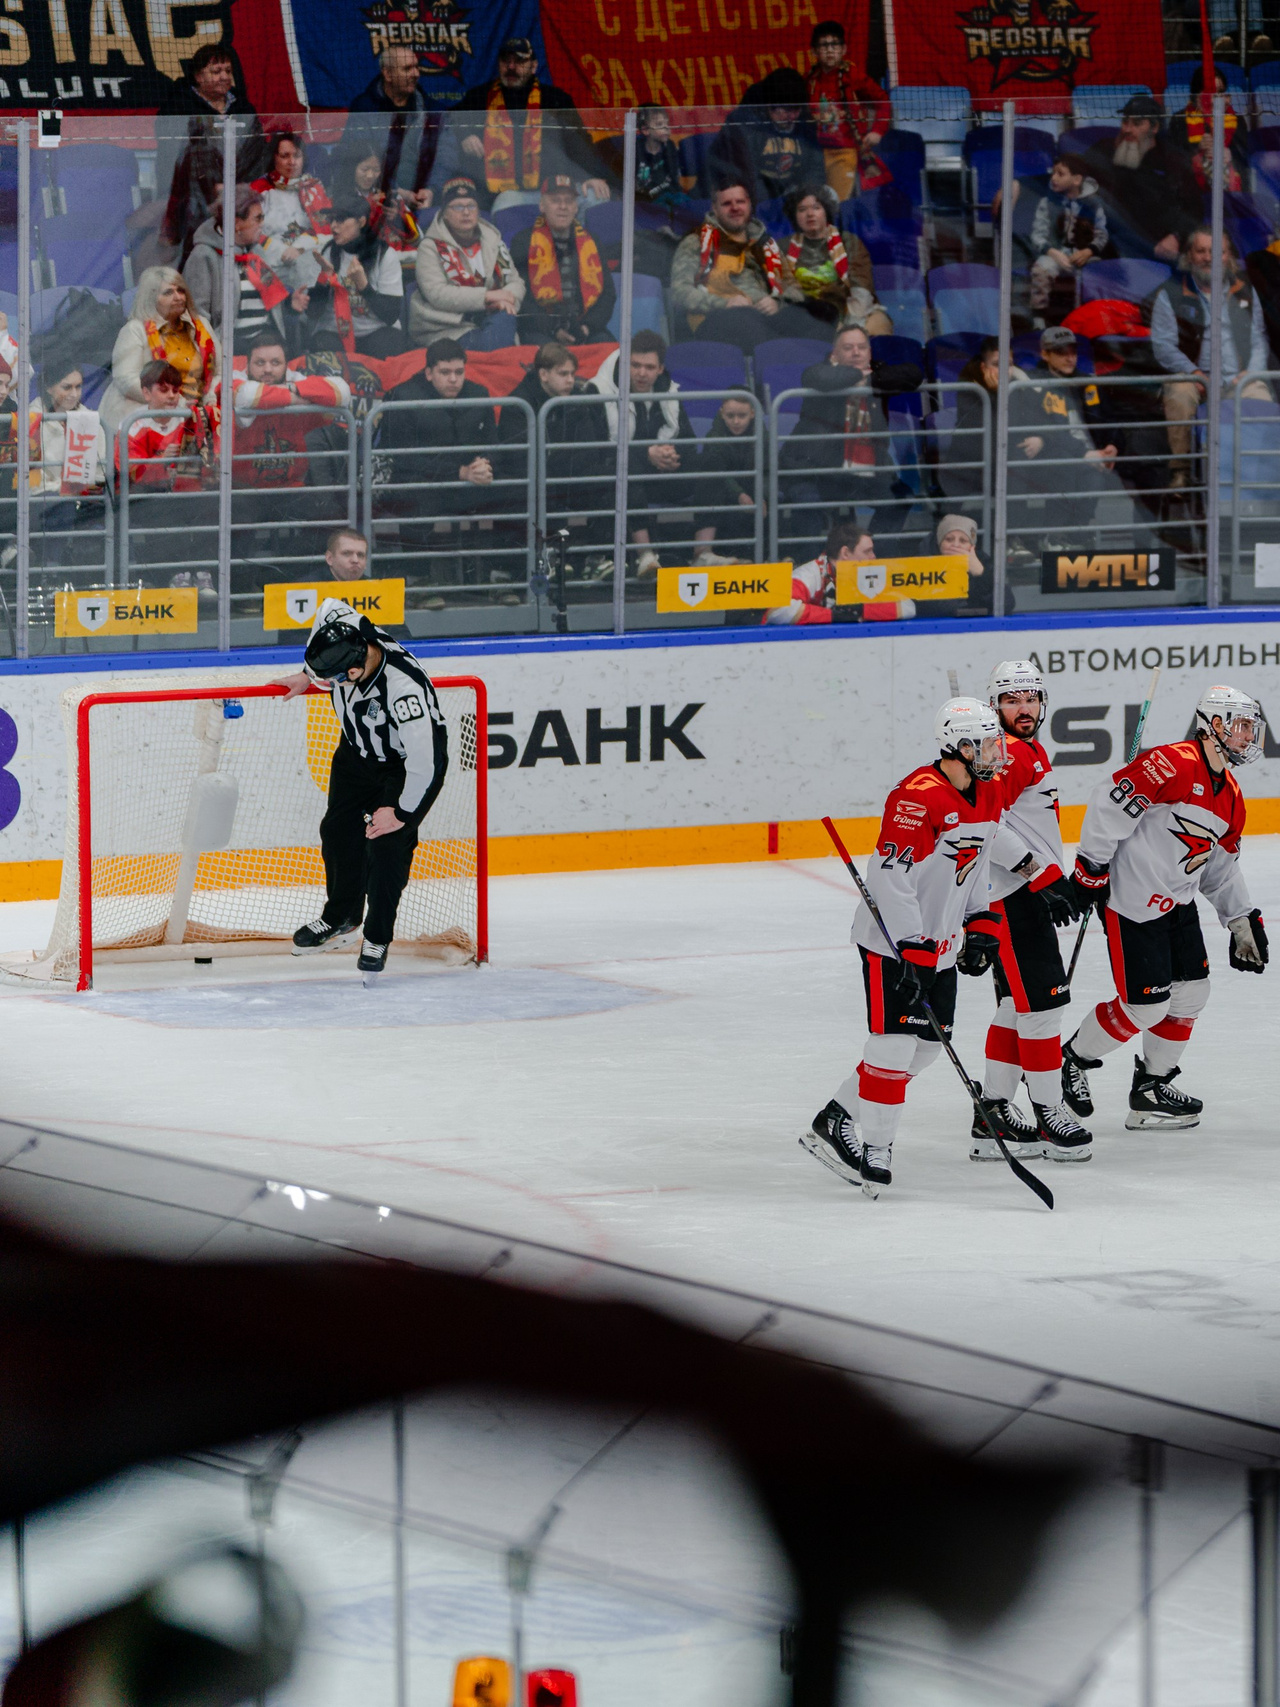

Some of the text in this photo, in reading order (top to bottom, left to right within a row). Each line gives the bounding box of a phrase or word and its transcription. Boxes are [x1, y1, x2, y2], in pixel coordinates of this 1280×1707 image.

[963, 27, 1094, 61] REDSTAR
[581, 54, 639, 110] ЗА
[713, 578, 770, 595] БАНК
[891, 570, 948, 587] БАНК
[1056, 553, 1161, 589] МАТЧ!
[114, 603, 176, 621] БАНК
[394, 696, 422, 721] 86
[460, 702, 707, 771] БАНК
[1109, 777, 1151, 818] 86
[880, 841, 915, 874] 24
[1074, 867, 1109, 887] CCM
